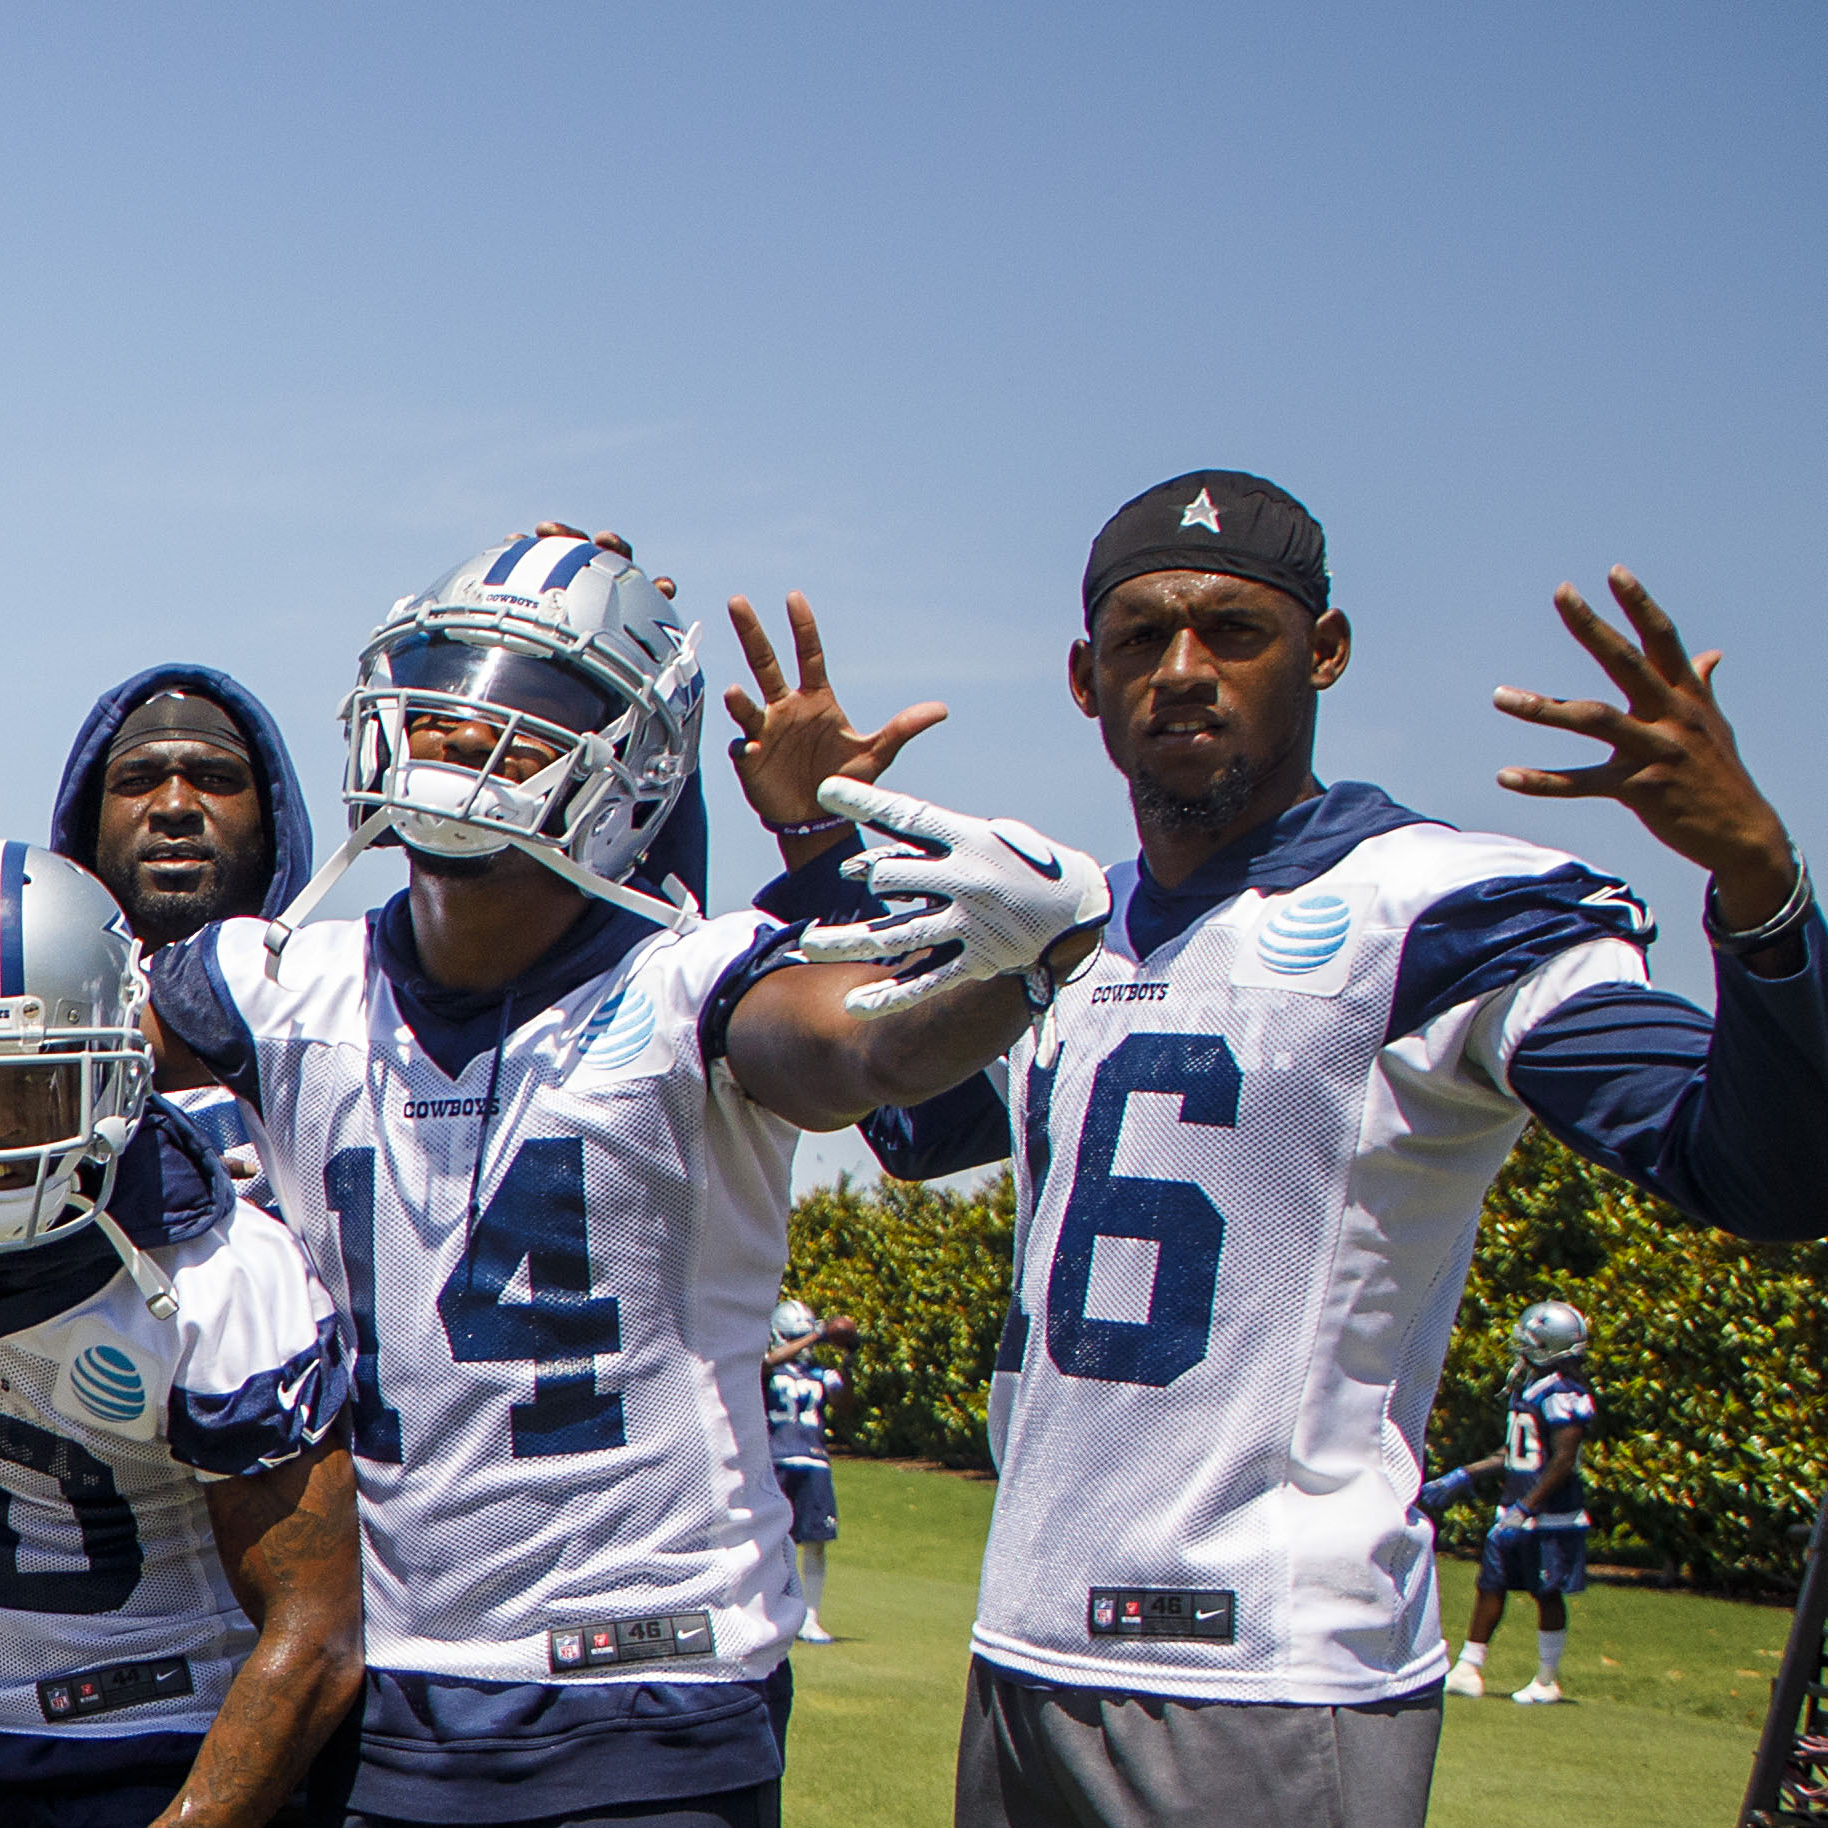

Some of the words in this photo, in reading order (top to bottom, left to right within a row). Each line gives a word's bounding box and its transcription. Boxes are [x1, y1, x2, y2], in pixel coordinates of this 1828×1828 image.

[486, 593, 540, 609] COWBOYS
[1091, 982, 1170, 1005] COWBOYS
[403, 1096, 501, 1120] COWBOYS
[323, 1135, 628, 1465] 14
[1150, 1595, 1183, 1615] 46
[628, 1621, 661, 1641] 46
